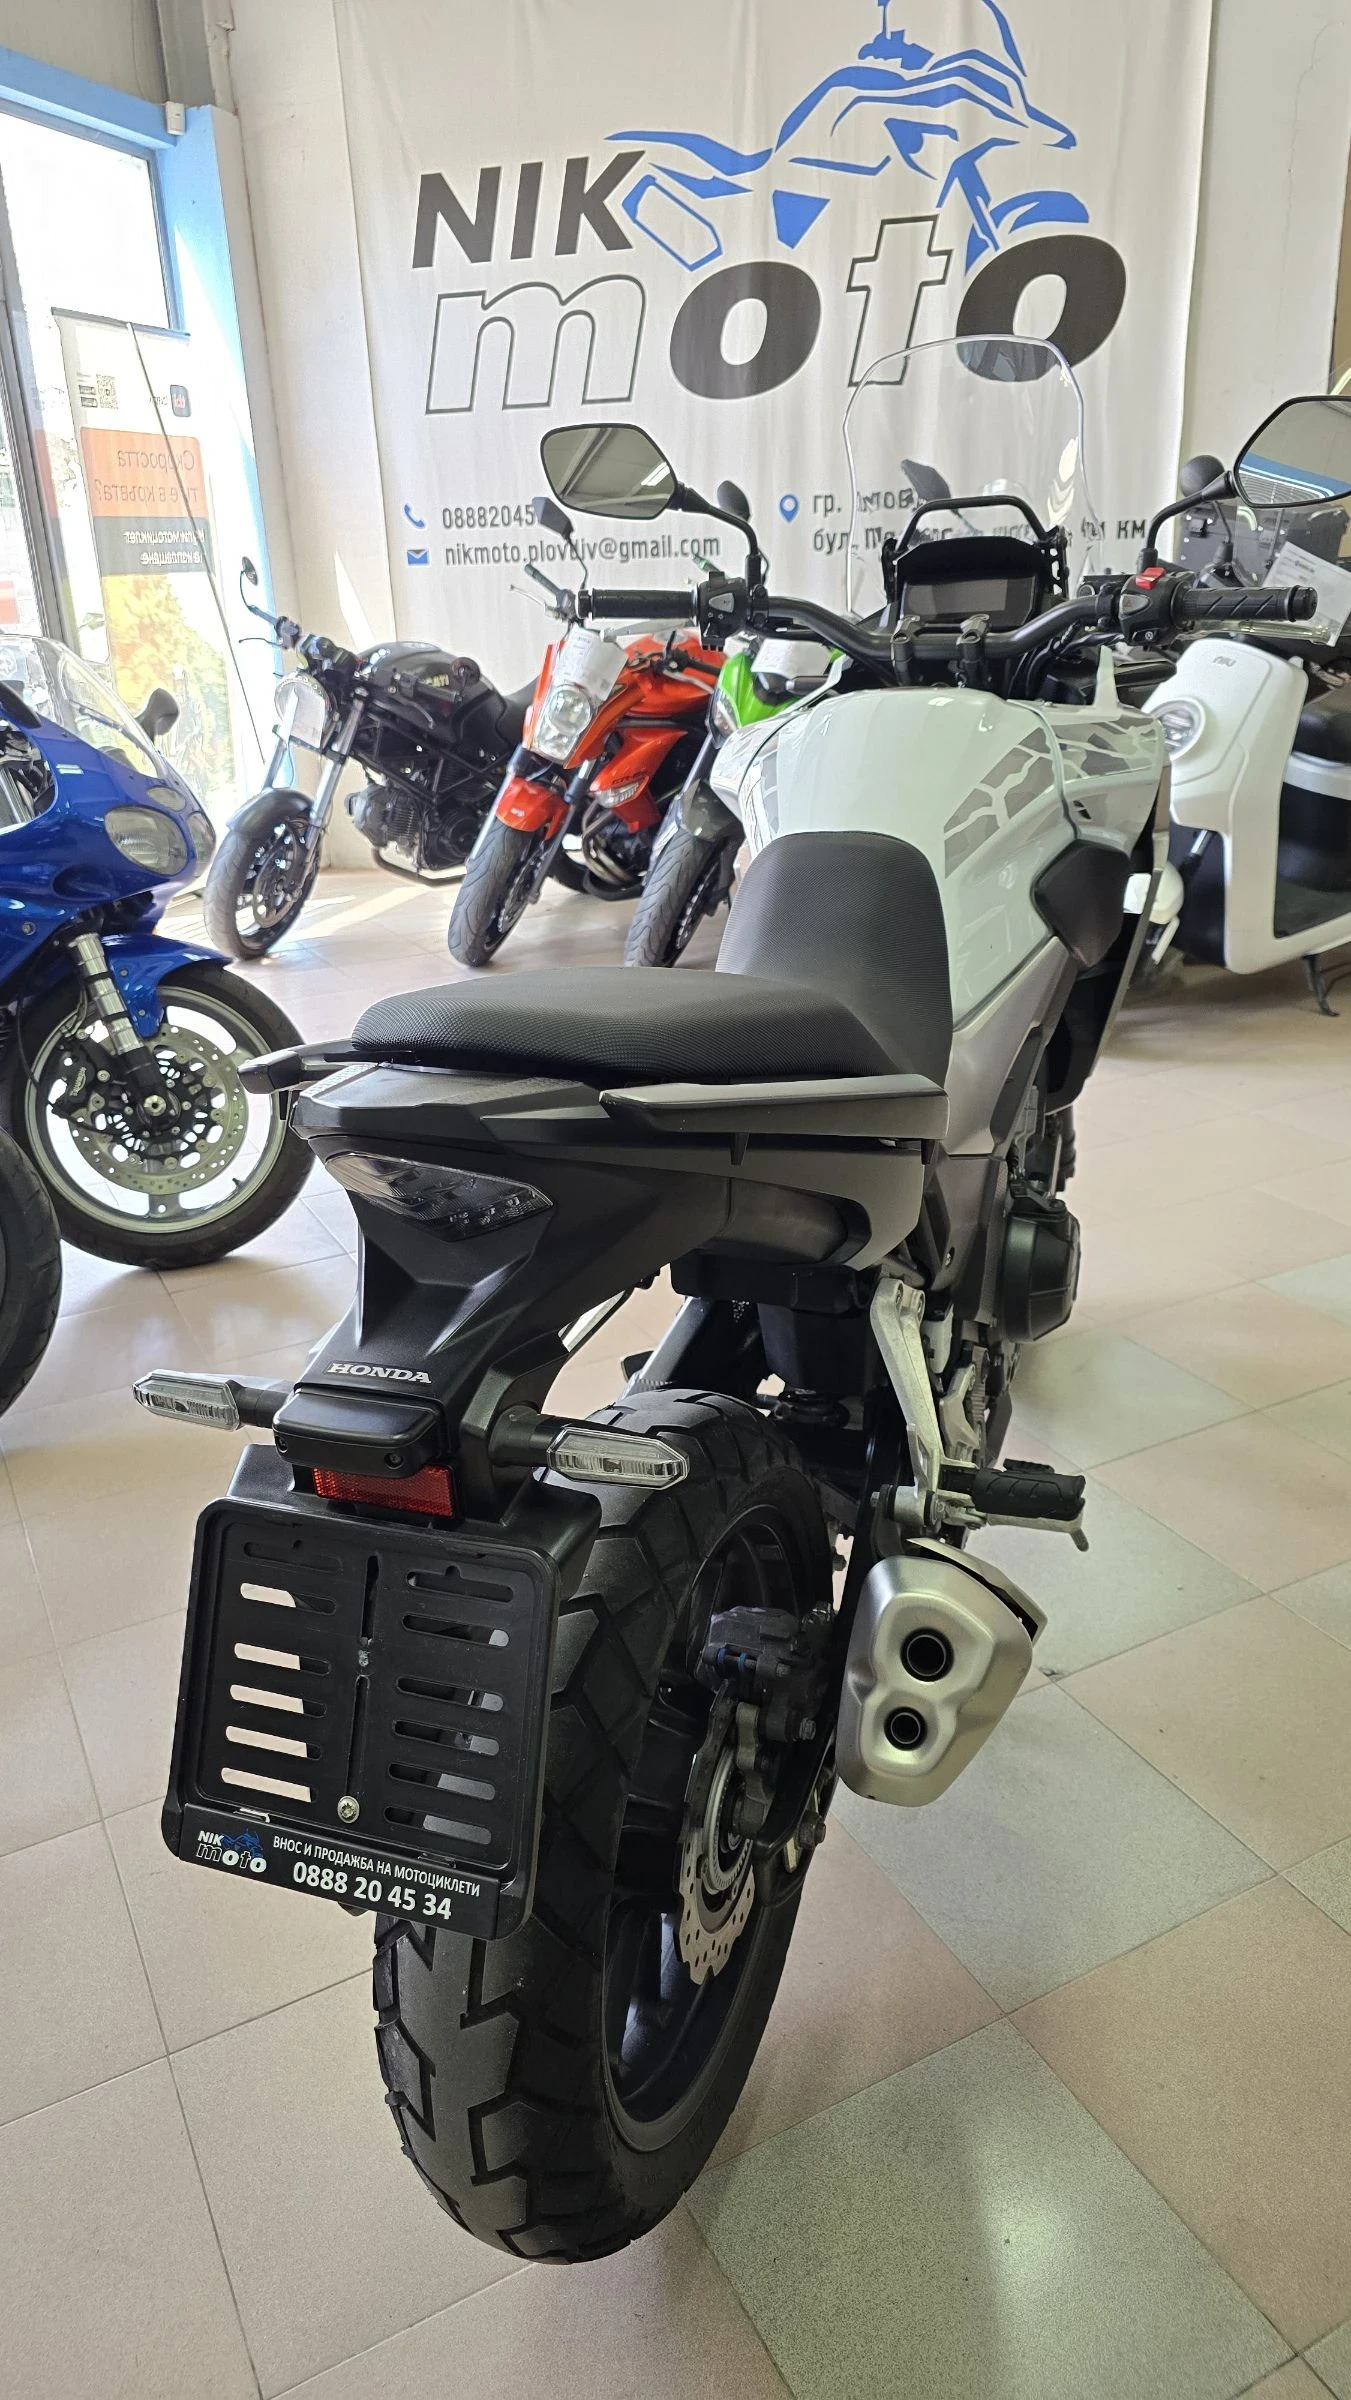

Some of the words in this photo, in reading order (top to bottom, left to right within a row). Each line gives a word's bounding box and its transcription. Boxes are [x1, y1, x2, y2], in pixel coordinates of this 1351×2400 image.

[412, 150, 646, 268] NIK
[425, 214, 1127, 416] moto
[442, 505, 536, 529] 08882045
[813, 494, 842, 517] гр.
[445, 535, 721, 566] nikmoto.plovdiv@gmail.com
[327, 1363, 431, 1383] HONDA
[198, 1831, 225, 1846] NIK
[196, 1843, 267, 1873] moto
[273, 1835, 301, 1854] ВНОС
[304, 1844, 312, 1857] И
[314, 1845, 374, 1872] ПРОДАЖБА
[376, 1861, 391, 1876] НА
[394, 1865, 480, 1897] МОТОЦИКЛЕТИ
[293, 1861, 347, 1893] 0888
[354, 1876, 382, 1901] 20
[387, 1886, 416, 1911] 45
[422, 1893, 451, 1920] 34
